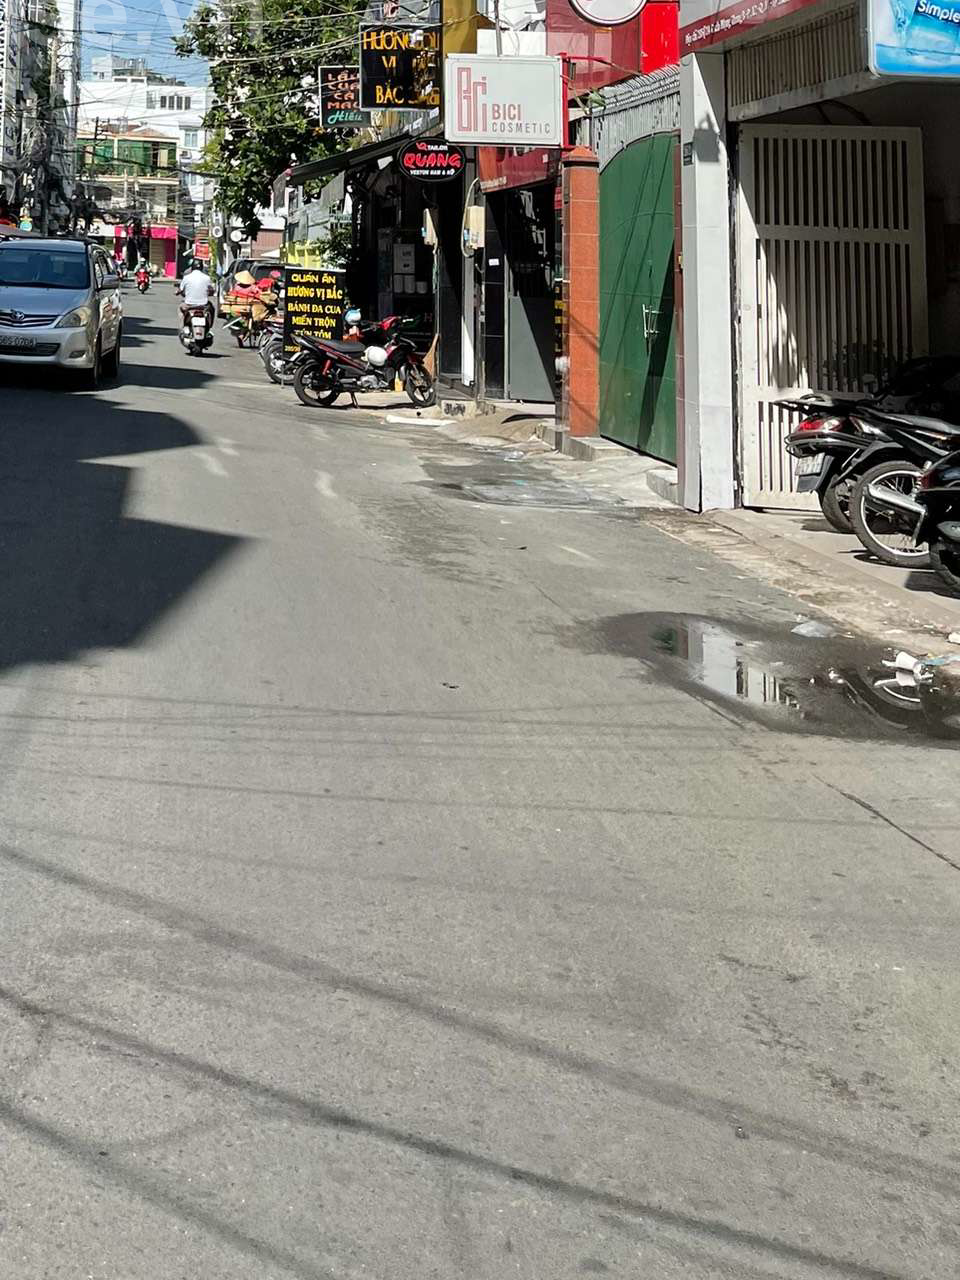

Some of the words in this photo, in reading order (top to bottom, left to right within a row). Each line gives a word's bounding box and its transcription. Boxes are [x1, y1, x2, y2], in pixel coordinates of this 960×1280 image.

[492, 104, 521, 120] BICI
[492, 122, 550, 134] COSMETIC
[404, 152, 461, 168] QUANG
[291, 272, 319, 283] QUÁN
[322, 273, 336, 284] ĂN
[287, 285, 314, 297] HƯƠNG
[316, 288, 325, 300] VỊ
[326, 285, 343, 299] BẮC
[287, 301, 310, 313] BÁNH
[312, 304, 323, 313] ĐA
[325, 305, 341, 314] CUA
[292, 314, 312, 326] MIẾN
[314, 316, 336, 328] TRỘN
